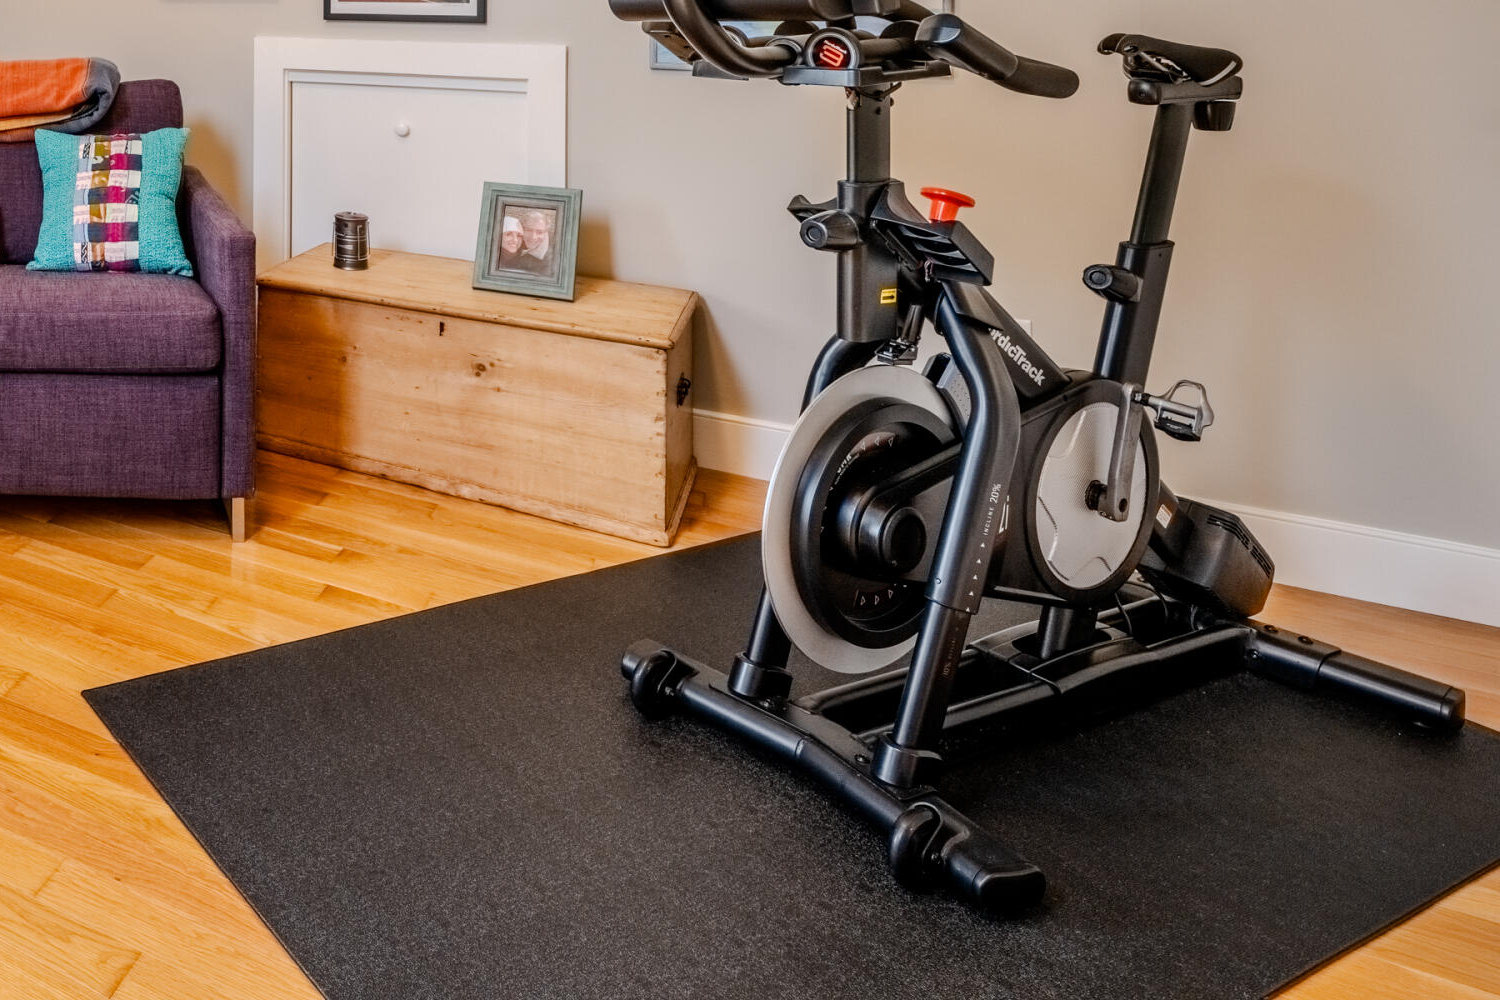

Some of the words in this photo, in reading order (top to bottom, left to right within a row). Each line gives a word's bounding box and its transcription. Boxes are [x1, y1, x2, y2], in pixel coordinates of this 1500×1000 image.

[988, 327, 1046, 386] rdicTrack
[983, 507, 994, 536] INCLINE
[989, 483, 1002, 504] 20%
